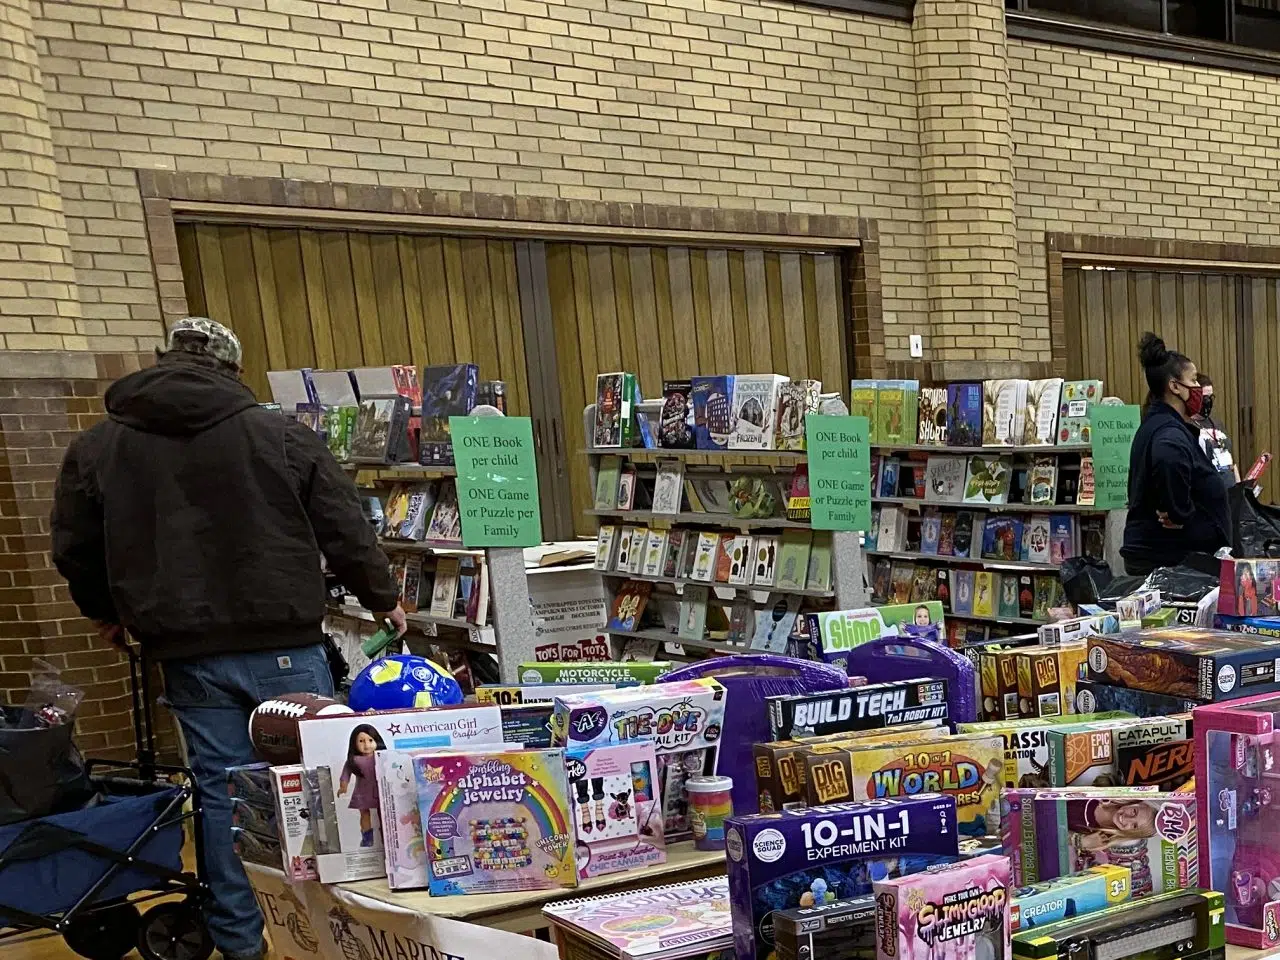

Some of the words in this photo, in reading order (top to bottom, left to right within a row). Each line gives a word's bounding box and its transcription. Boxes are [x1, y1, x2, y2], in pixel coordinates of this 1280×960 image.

[1098, 420, 1114, 430] ONE
[1116, 420, 1134, 430] Book
[463, 437, 490, 448] ONE
[493, 437, 522, 448] Book
[816, 432, 838, 442] ONE
[840, 433, 862, 443] Book
[1114, 434, 1131, 444] child
[822, 450, 834, 460] per
[838, 448, 858, 458] child
[472, 457, 489, 468] per
[492, 454, 518, 466] child
[1100, 464, 1116, 474] ONE
[818, 479, 838, 489] ONE
[841, 481, 864, 491] Game
[468, 488, 494, 500] ONE
[498, 490, 529, 500] Game
[827, 496, 852, 506] Puzzle
[855, 498, 868, 508] per
[466, 509, 478, 518] or
[480, 507, 514, 518] Puzzle
[518, 510, 534, 520] per
[828, 511, 856, 523] Family
[484, 525, 520, 538] Family
[830, 618, 881, 649] slime
[536, 647, 558, 661] TOYS
[562, 648, 578, 659] FOR
[584, 644, 606, 657] TOTS
[559, 669, 630, 677] MOTORCYCLE
[794, 698, 852, 726] BUILD
[857, 689, 907, 718] TECH
[904, 709, 930, 722] ROBOT
[932, 705, 946, 717] KIT
[404, 722, 456, 734] American
[458, 718, 478, 730] Girl
[1118, 724, 1184, 741] CATAPULT
[452, 729, 478, 738] Crafts
[678, 732, 692, 744] KIT
[1091, 732, 1110, 747] EPIC
[1092, 746, 1110, 759] LAB
[468, 762, 512, 776] sparkling
[814, 760, 844, 783] DIG
[283, 778, 300, 789] LEGO
[458, 773, 526, 790] alphabet
[872, 762, 980, 798] WORLD
[464, 788, 524, 804] jewelry
[818, 784, 848, 800] TEAM
[801, 809, 910, 849] 10-IN-1
[536, 833, 570, 848] UNICORN
[754, 840, 786, 849] SCIENCE
[544, 842, 568, 853] POWER
[757, 845, 782, 853] SQUAD
[807, 840, 886, 860] EXPERIMENT
[890, 835, 908, 848] KIT
[614, 856, 643, 870] CANVAS
[1023, 900, 1064, 920] CREATOR
[938, 916, 986, 942] JEWELRY
